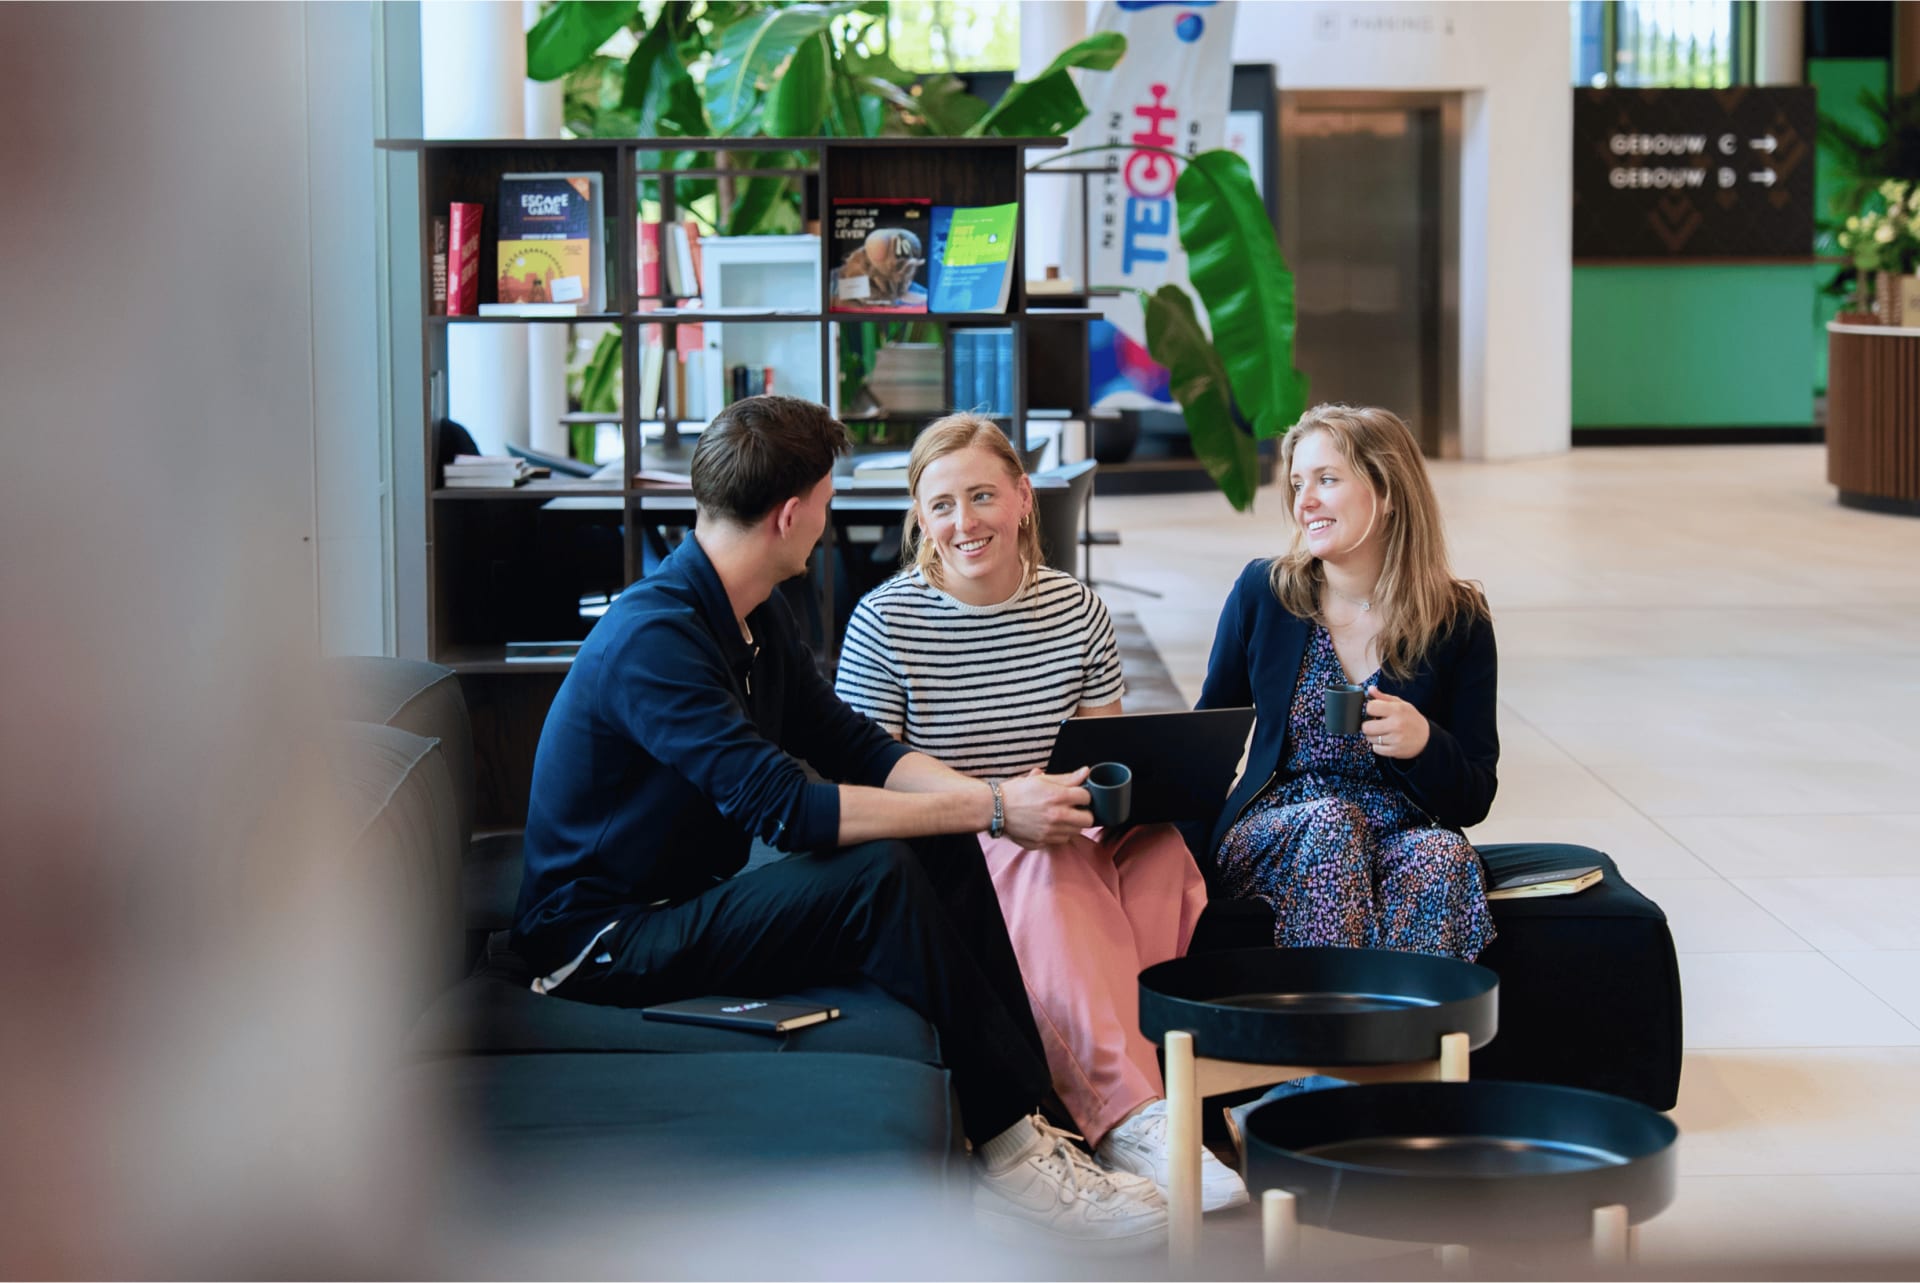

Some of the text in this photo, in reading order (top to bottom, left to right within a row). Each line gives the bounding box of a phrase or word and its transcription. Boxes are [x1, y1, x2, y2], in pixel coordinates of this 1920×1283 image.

[1610, 134, 1737, 154] GEBOUW C
[1609, 168, 1736, 189] GEBOUW D
[1122, 105, 1177, 274] TECH
[521, 194, 569, 207] ESCAPE
[528, 204, 560, 215] GAME
